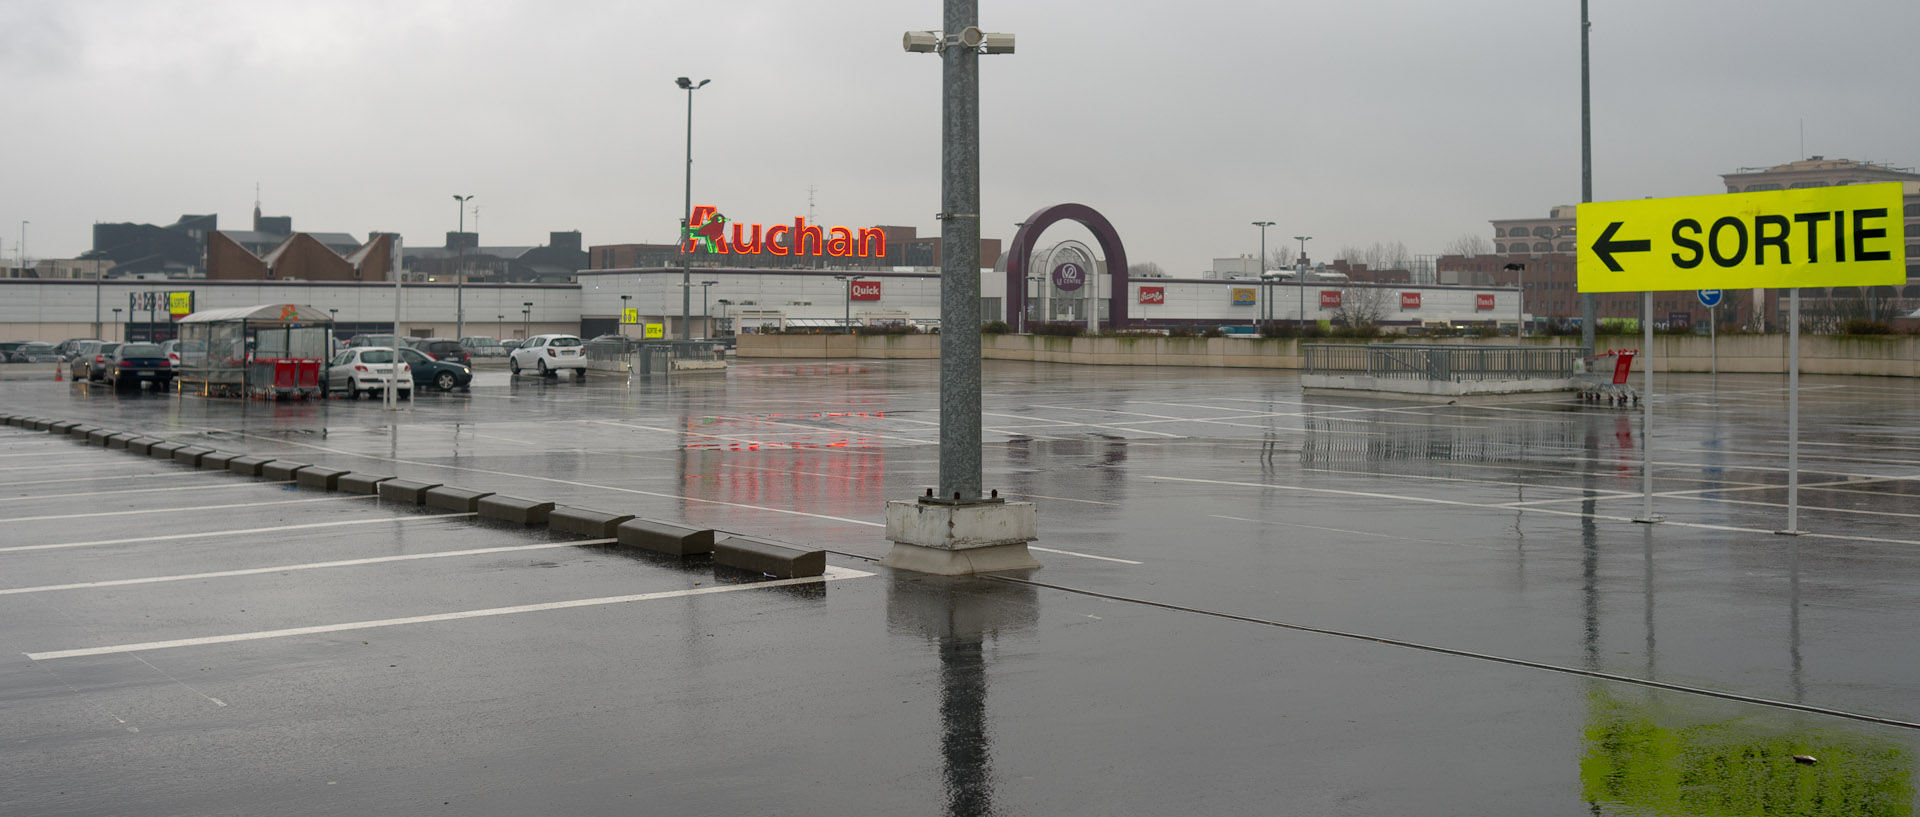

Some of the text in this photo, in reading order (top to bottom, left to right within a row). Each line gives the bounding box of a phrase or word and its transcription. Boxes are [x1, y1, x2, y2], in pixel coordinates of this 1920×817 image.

[681, 205, 886, 257] Auchan
[1671, 207, 1891, 269] SORTIE
[852, 285, 879, 297] Quick
